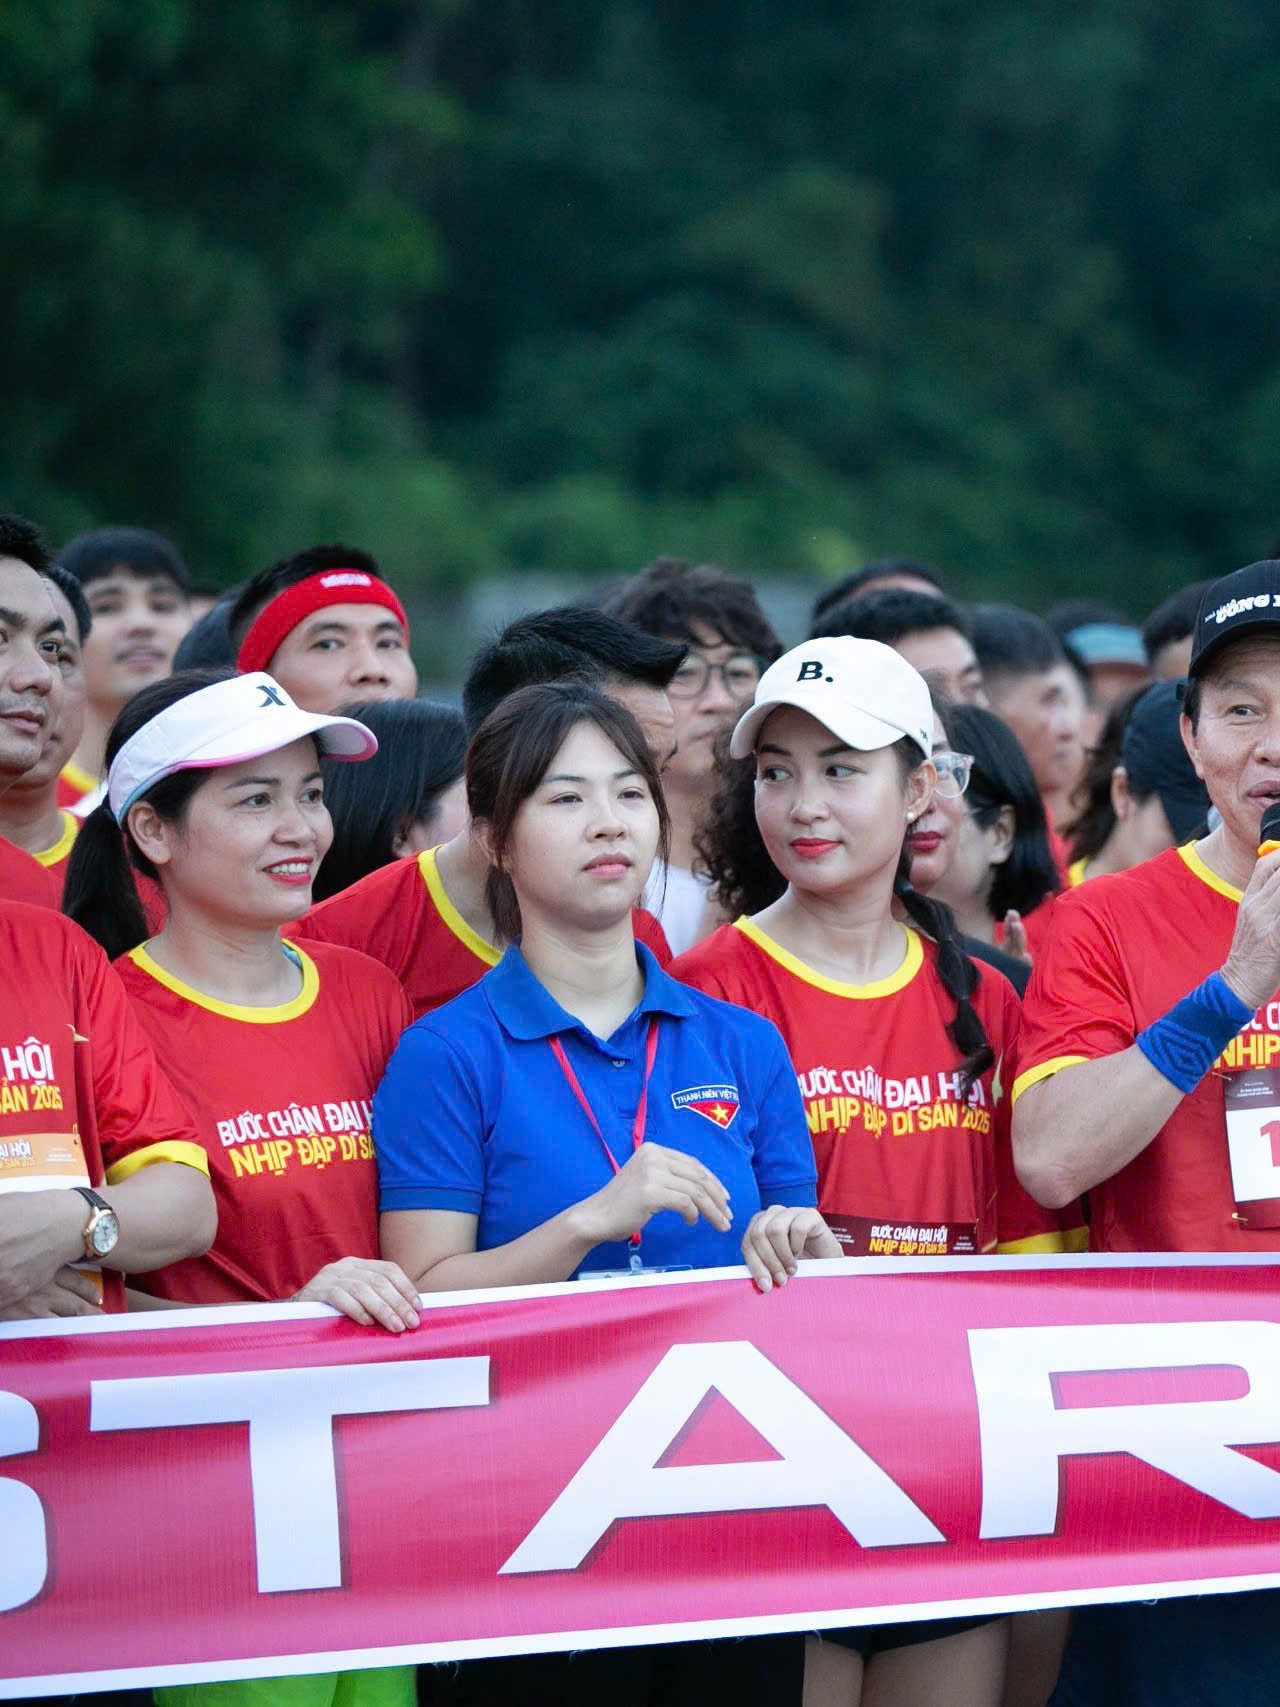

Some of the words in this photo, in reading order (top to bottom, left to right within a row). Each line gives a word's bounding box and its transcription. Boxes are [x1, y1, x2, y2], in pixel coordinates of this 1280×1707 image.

[796, 661, 834, 683] B.
[0, 1036, 55, 1086] HỘI
[31, 1084, 64, 1111] 2025
[676, 1092, 701, 1104] THANH
[797, 1066, 842, 1098] ƯỚC
[841, 1065, 883, 1105] CHÂN
[884, 1075, 931, 1111] ĐẠI
[217, 1110, 270, 1147] BƯỚC
[268, 1103, 325, 1137] CHÂN
[323, 1101, 364, 1136] ĐẠI
[892, 1110, 914, 1137] DI
[918, 1096, 958, 1132] SẢN
[229, 1140, 293, 1177] NHỊP
[295, 1132, 336, 1169] ĐẬP
